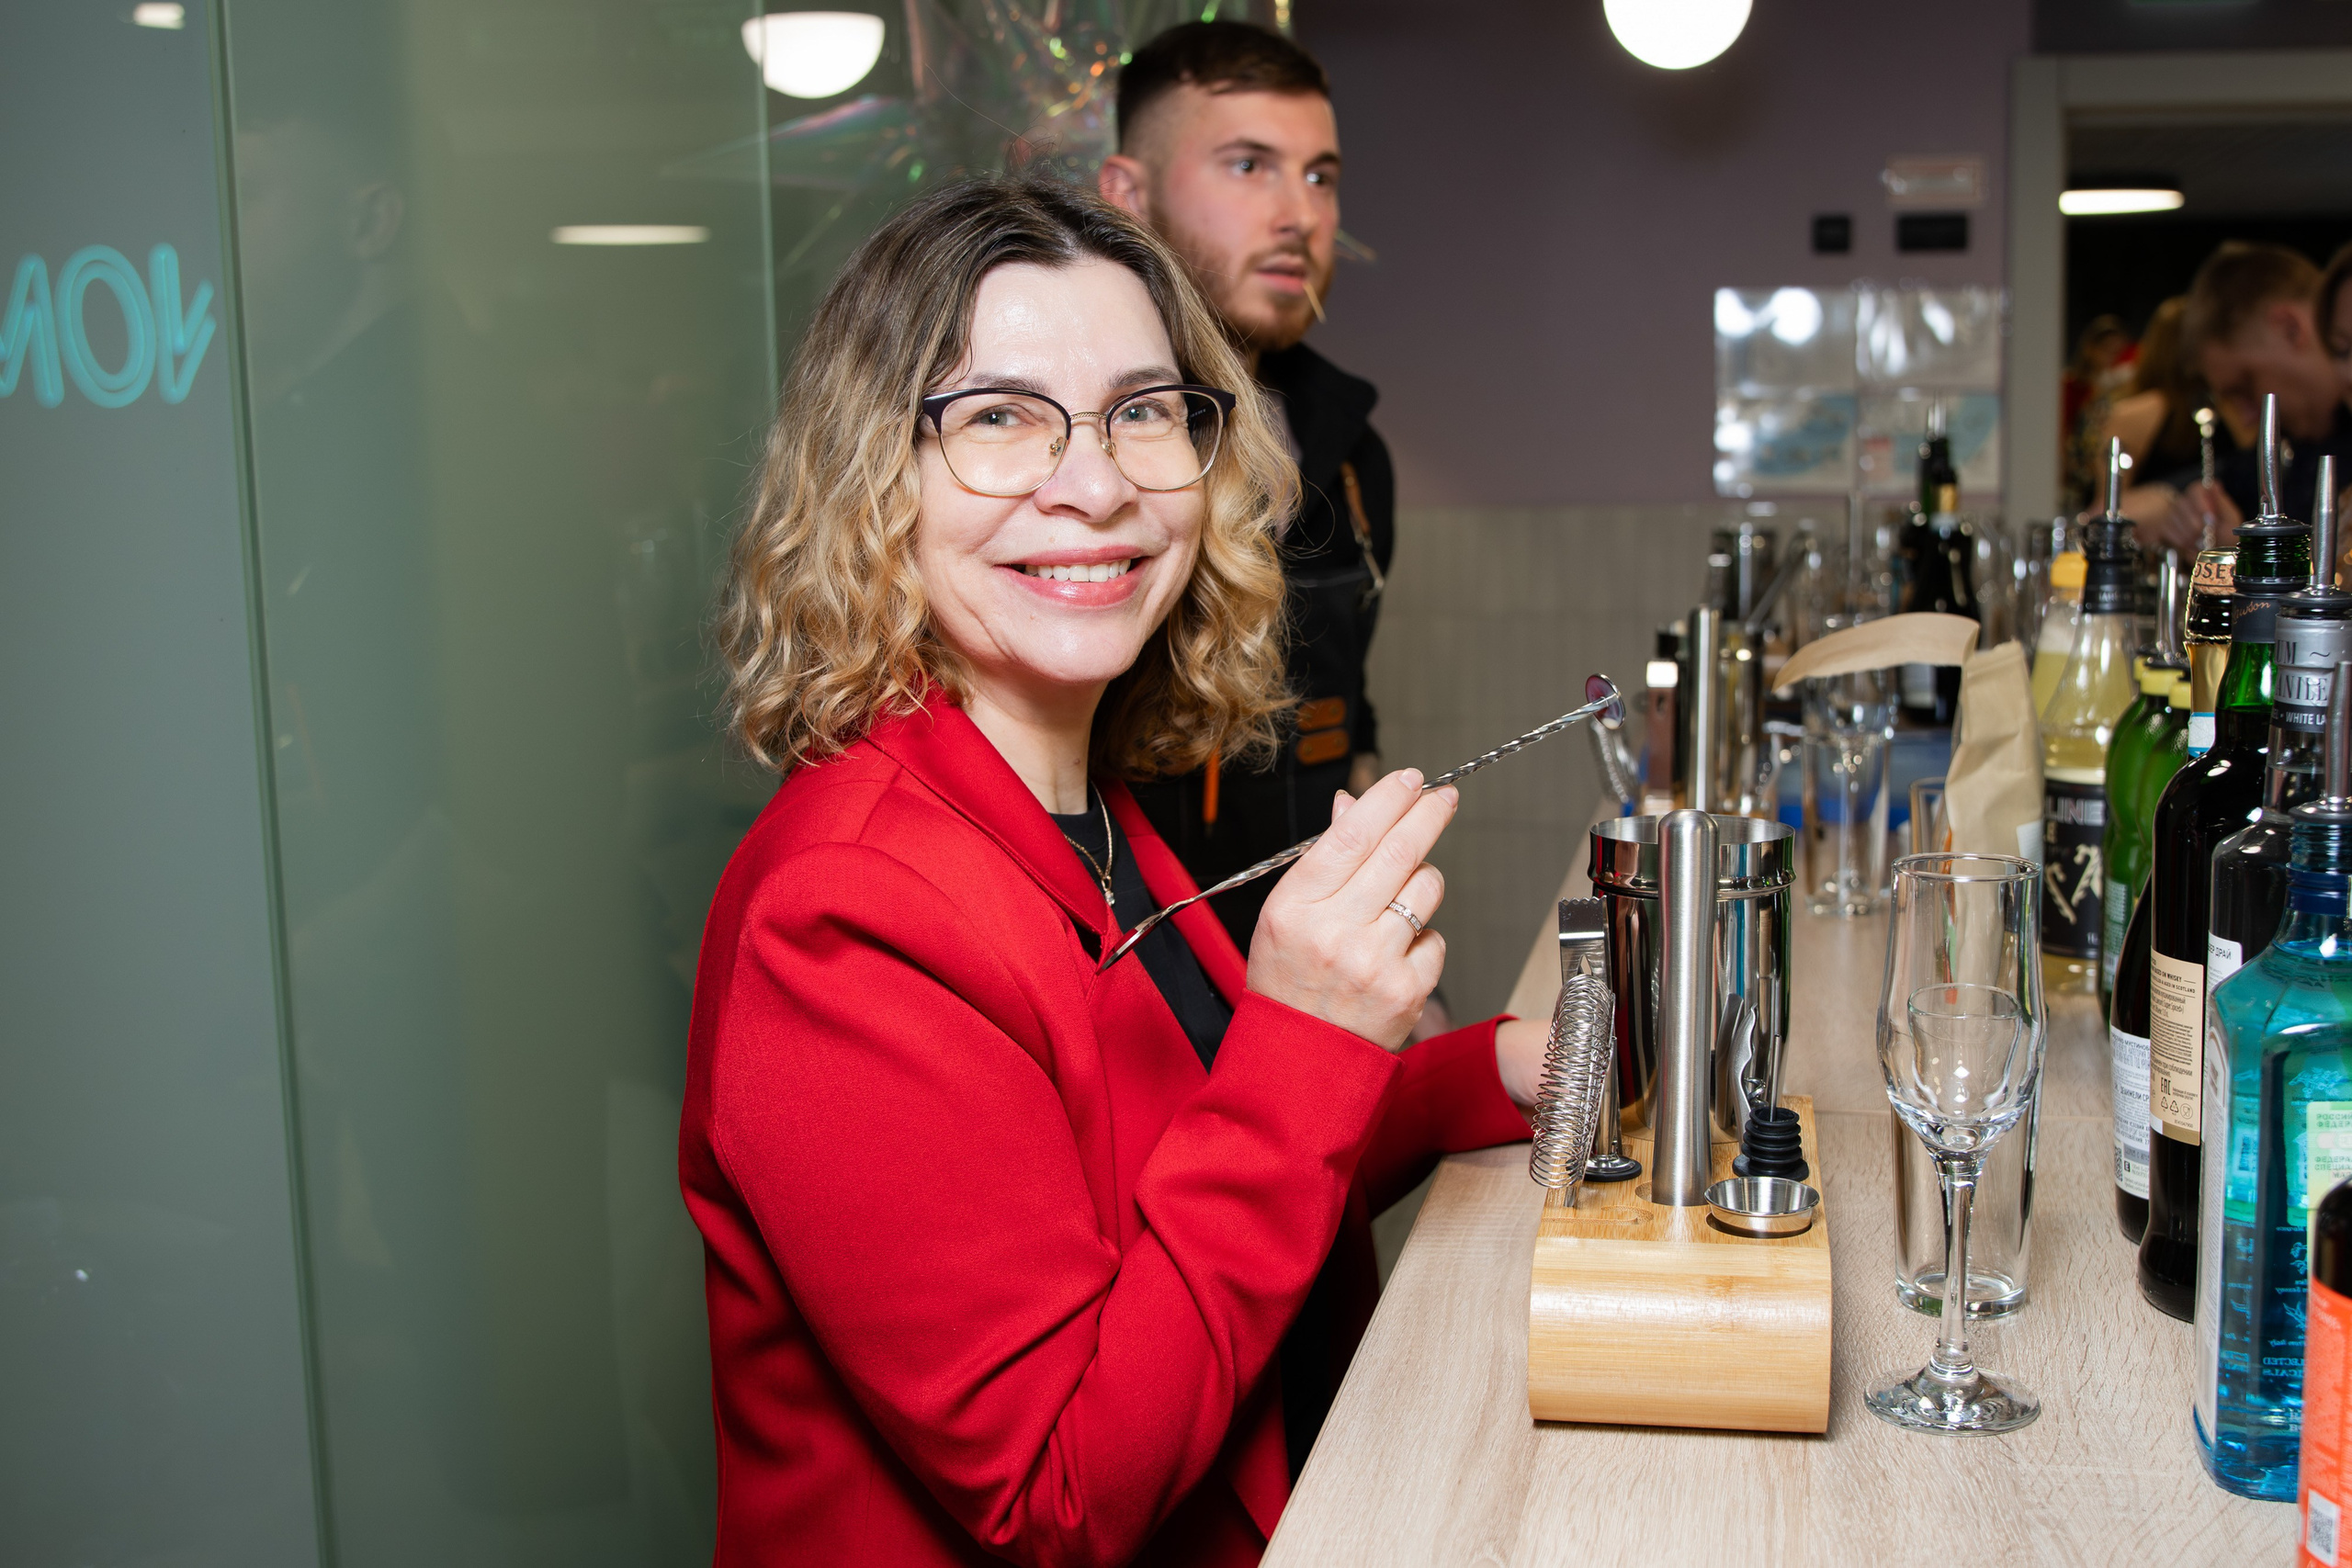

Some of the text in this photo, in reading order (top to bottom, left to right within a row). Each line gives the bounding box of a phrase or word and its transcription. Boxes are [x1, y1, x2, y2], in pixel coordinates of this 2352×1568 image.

[2286, 711, 2313, 725] WHITE
[2215, 947, 2231, 960] ДРАЙ
[2167, 972, 2182, 983] WHISKY
[2176, 984, 2196, 994] SCOTLAND
